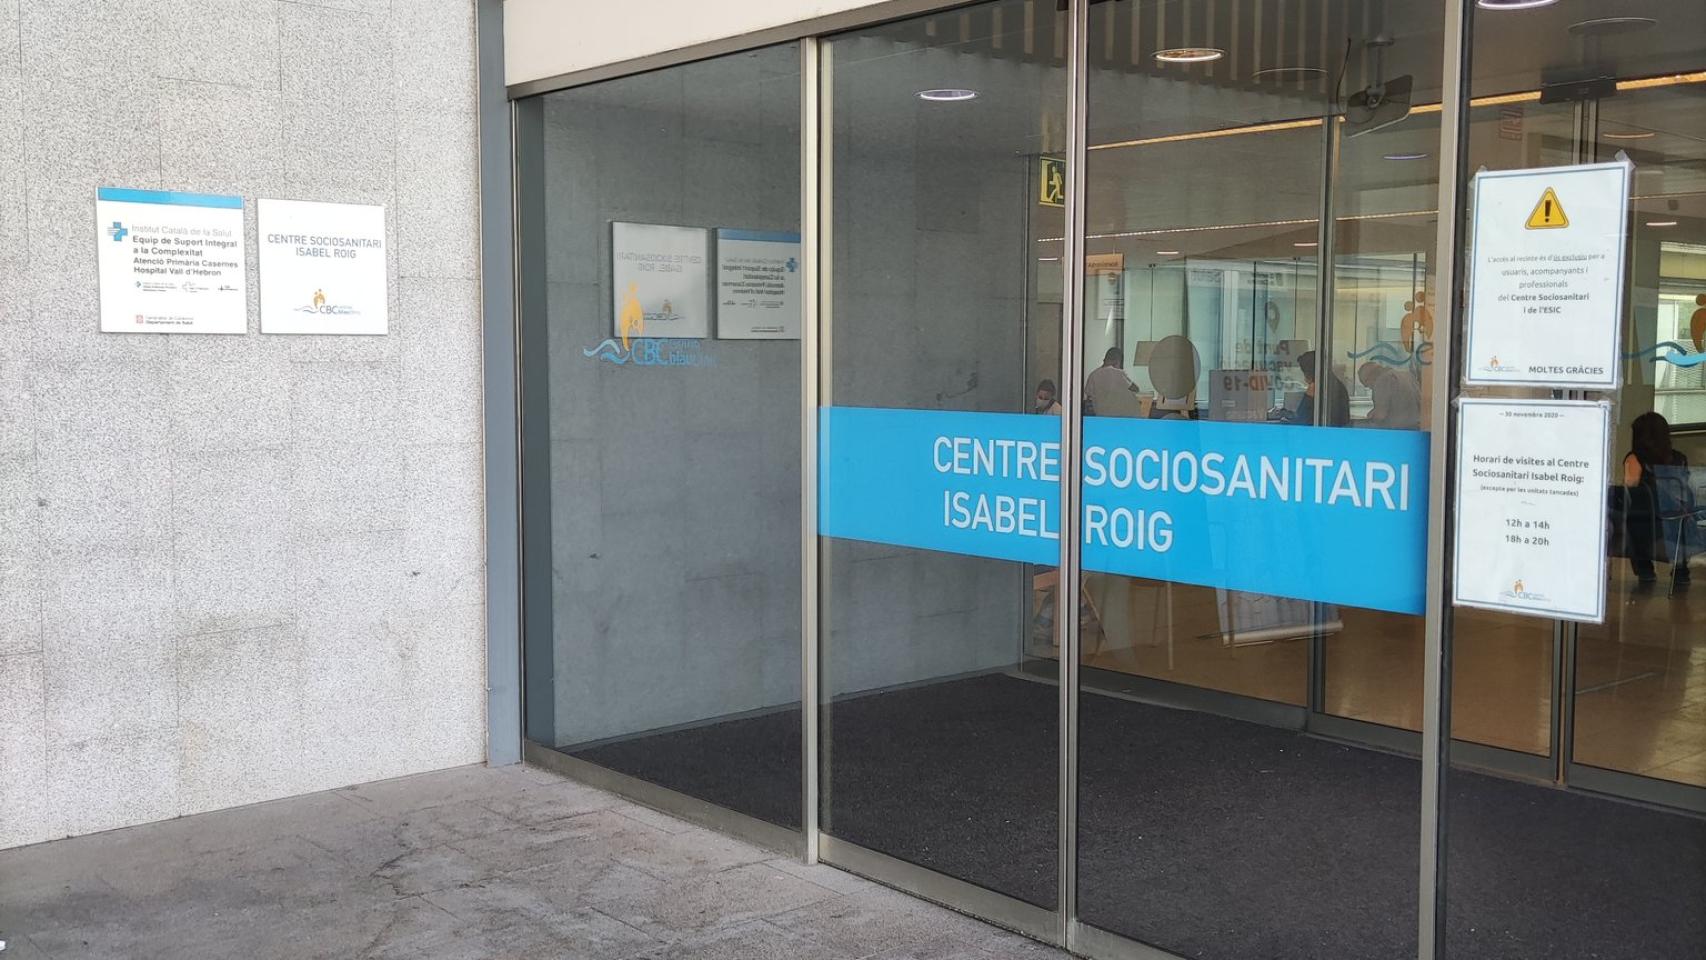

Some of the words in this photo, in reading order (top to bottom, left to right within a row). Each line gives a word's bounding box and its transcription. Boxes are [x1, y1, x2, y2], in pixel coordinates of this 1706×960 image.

[131, 224, 160, 234] Institut
[132, 235, 159, 246] Equip
[161, 236, 172, 245] de
[174, 237, 204, 248] Suport
[205, 238, 238, 249] Integral
[267, 233, 308, 245] CENTRE
[310, 236, 382, 249] SOCIOSANITARI
[140, 246, 149, 255] la
[151, 247, 203, 258] Complexitat
[296, 246, 332, 258] ISABEL
[334, 248, 357, 259] ROIG
[133, 256, 164, 266] Atenció
[202, 260, 238, 268] Casernes
[134, 266, 167, 276] Hospital
[169, 268, 184, 276] Vall
[185, 268, 222, 277] d'Hebron
[1501, 269, 1529, 277] usuaris,
[1530, 267, 1584, 276] acompanyants
[1518, 280, 1568, 289] professionals
[1538, 292, 1590, 301] Sociosanitari
[1528, 366, 1564, 374] MOLTES
[1566, 365, 1604, 375] GRÀCIES
[1472, 454, 1501, 464] Horari
[1502, 456, 1514, 465] de
[1516, 456, 1545, 466] visites
[1546, 458, 1556, 467] al
[1557, 458, 1590, 468] Centre
[933, 435, 1060, 483] CENTRE
[1084, 445, 1409, 512] SOCIOSANITARI
[1472, 468, 1530, 480] Sociosanitari
[1531, 472, 1559, 482] Isabel
[1561, 474, 1584, 484] Roig:
[1527, 487, 1548, 495] unitats
[943, 490, 1059, 541] ISABEL
[1085, 504, 1174, 553] ROIG
[1506, 518, 1522, 528] 12h
[1533, 520, 1550, 530] 14h
[1505, 534, 1522, 544] 18h
[1532, 536, 1550, 546] 20h
